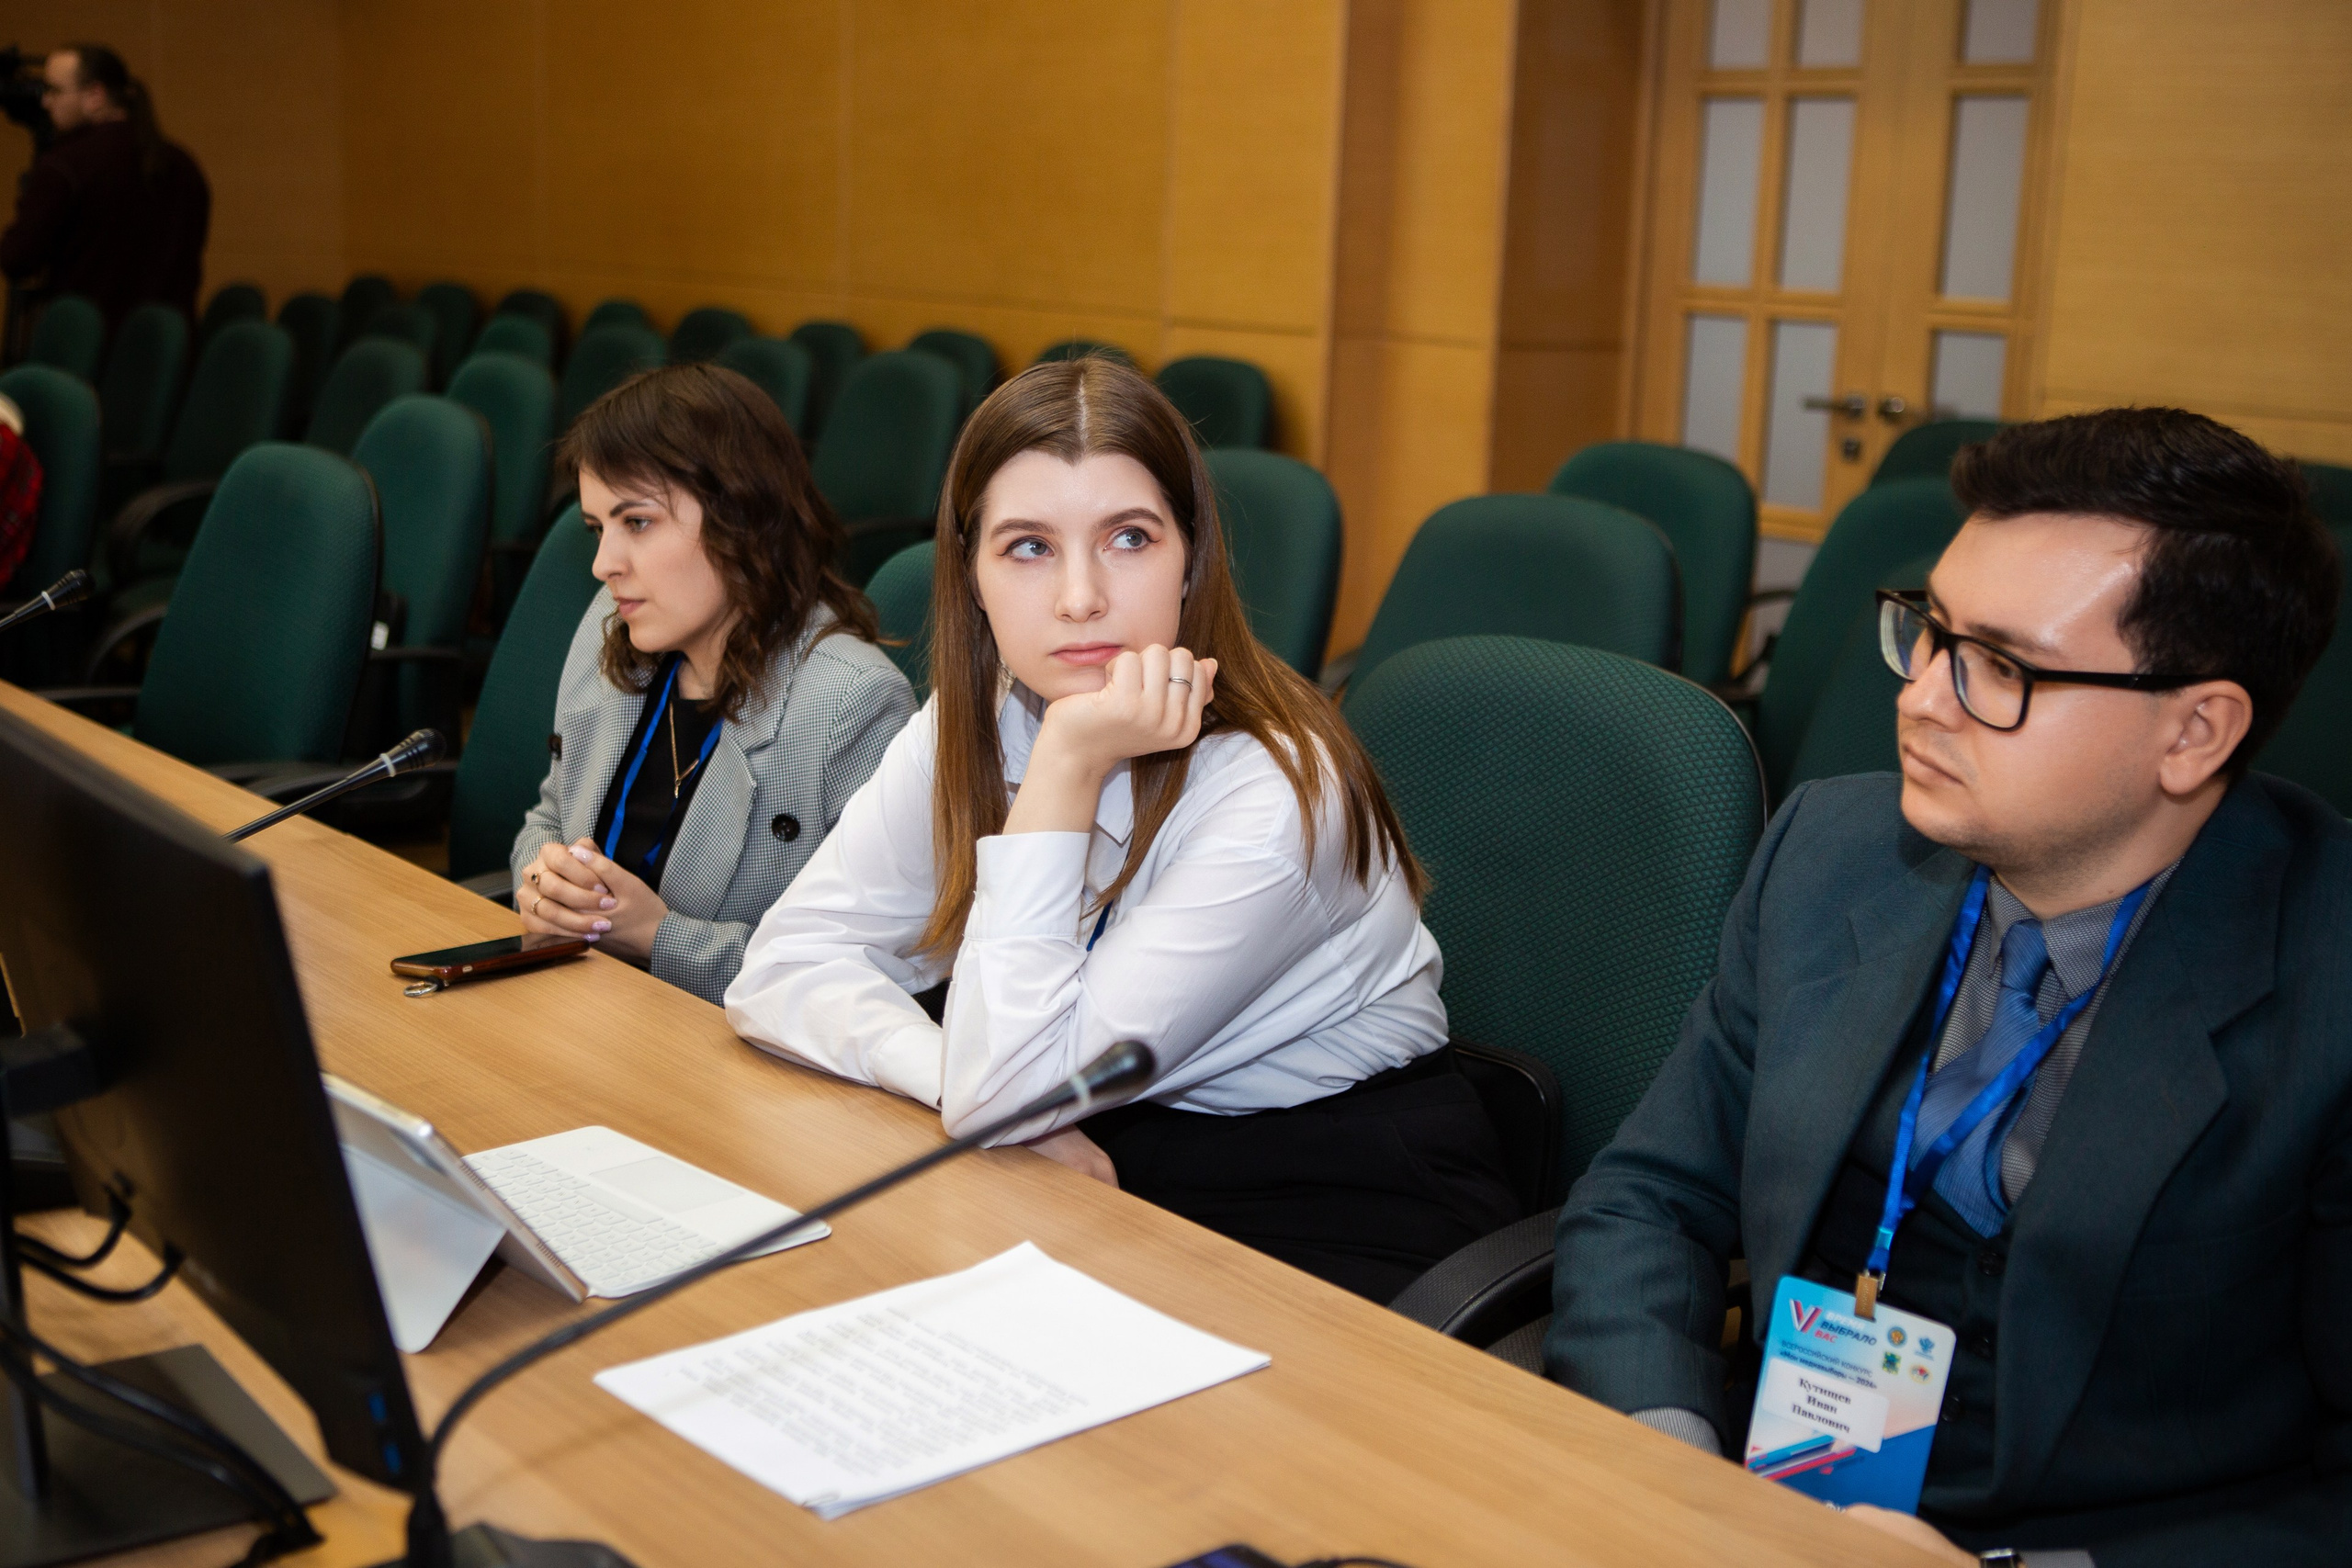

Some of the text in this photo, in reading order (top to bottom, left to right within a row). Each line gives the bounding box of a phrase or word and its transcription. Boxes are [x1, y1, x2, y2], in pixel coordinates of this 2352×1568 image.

[1815, 1329, 1838, 1343] ВАС
[1820, 1321, 1877, 1346] ВЫБРАЛО
[1781, 1340, 1872, 1377] ВСЕРОССИЙСКИЙ КОНКУРС
[1799, 1357, 1848, 1379] медиавыборы
[1806, 1394, 1837, 1414] Иван
[1792, 1404, 1850, 1433] Павлович
